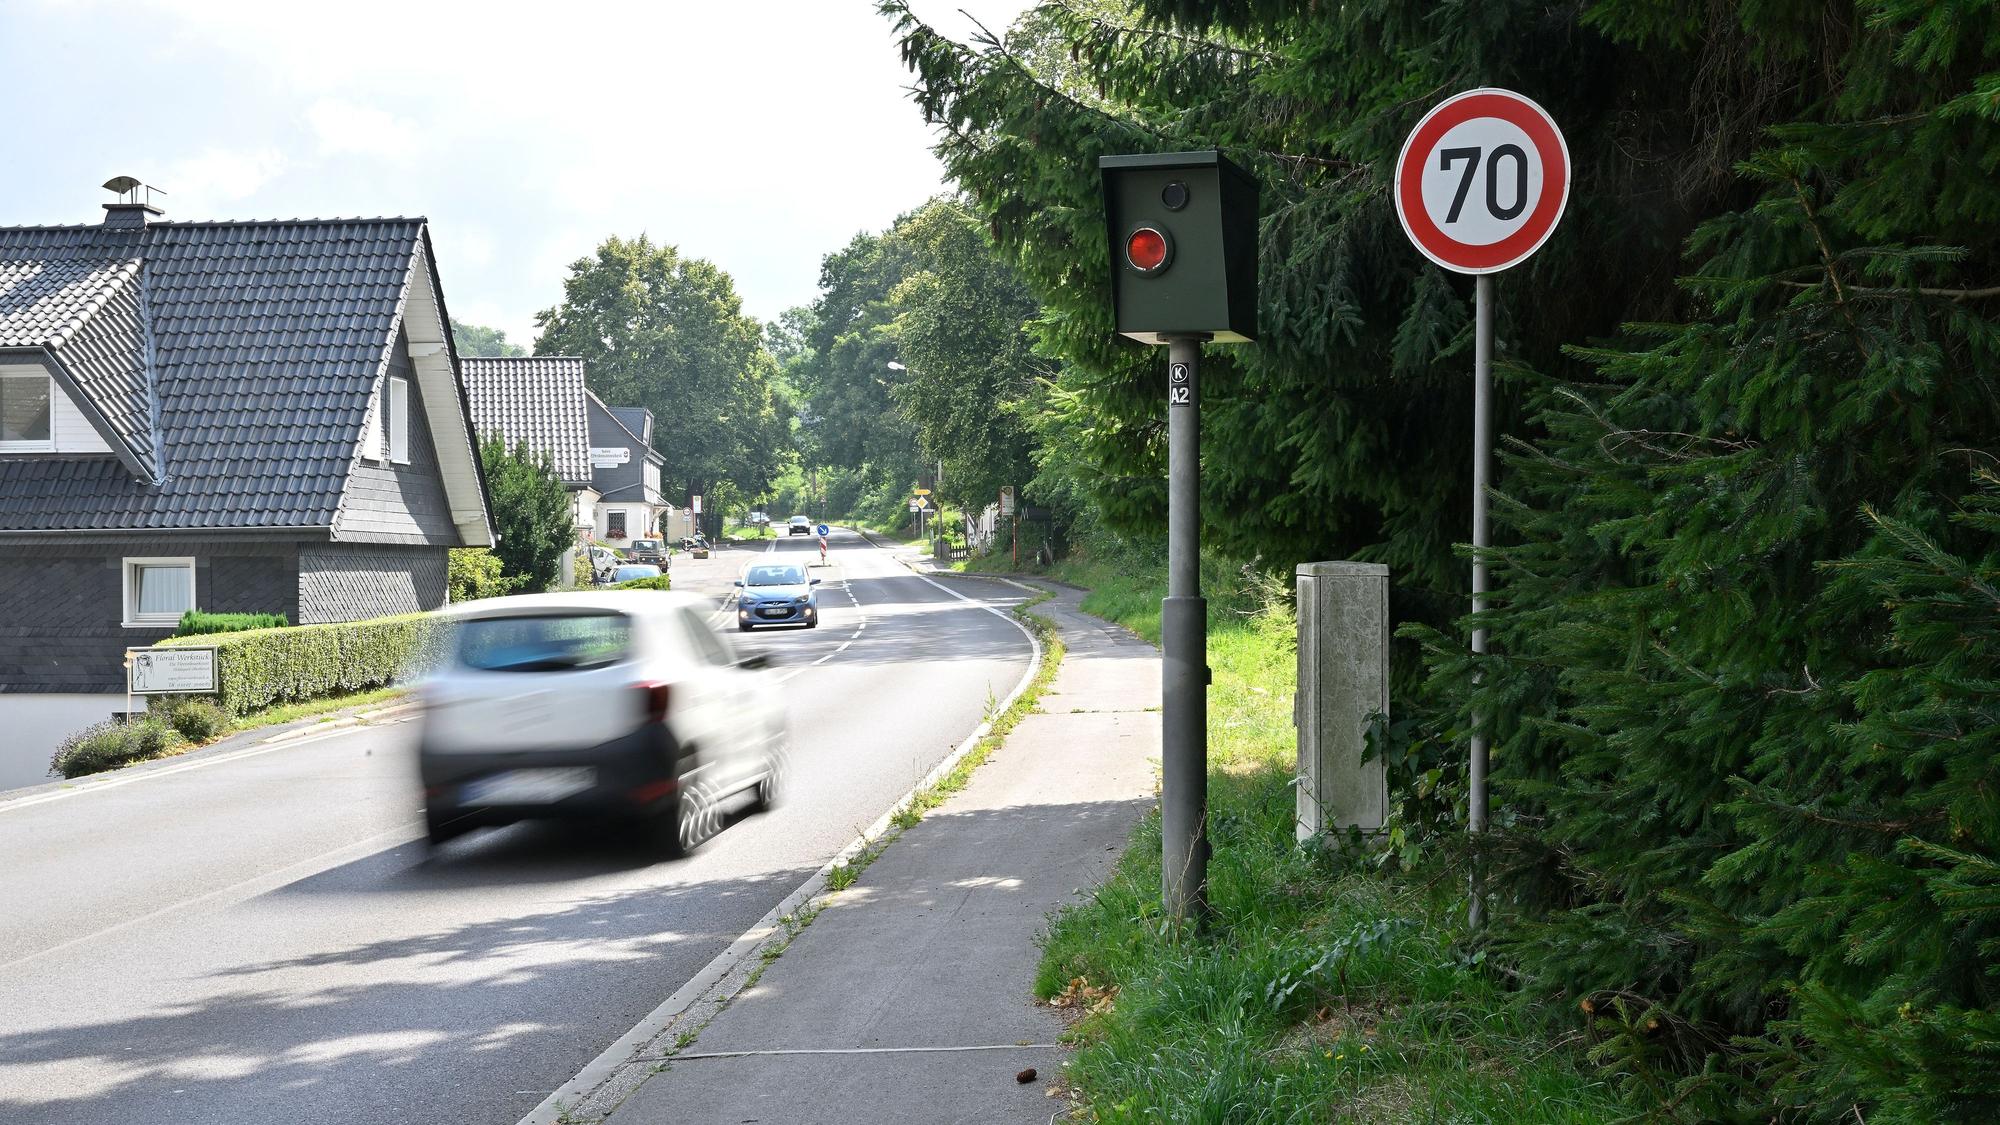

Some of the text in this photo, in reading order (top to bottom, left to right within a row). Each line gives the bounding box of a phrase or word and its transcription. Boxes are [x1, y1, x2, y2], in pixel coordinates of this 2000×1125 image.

[1440, 143, 1528, 223] 70
[1174, 367, 1183, 379] K
[1171, 387, 1189, 403] A2
